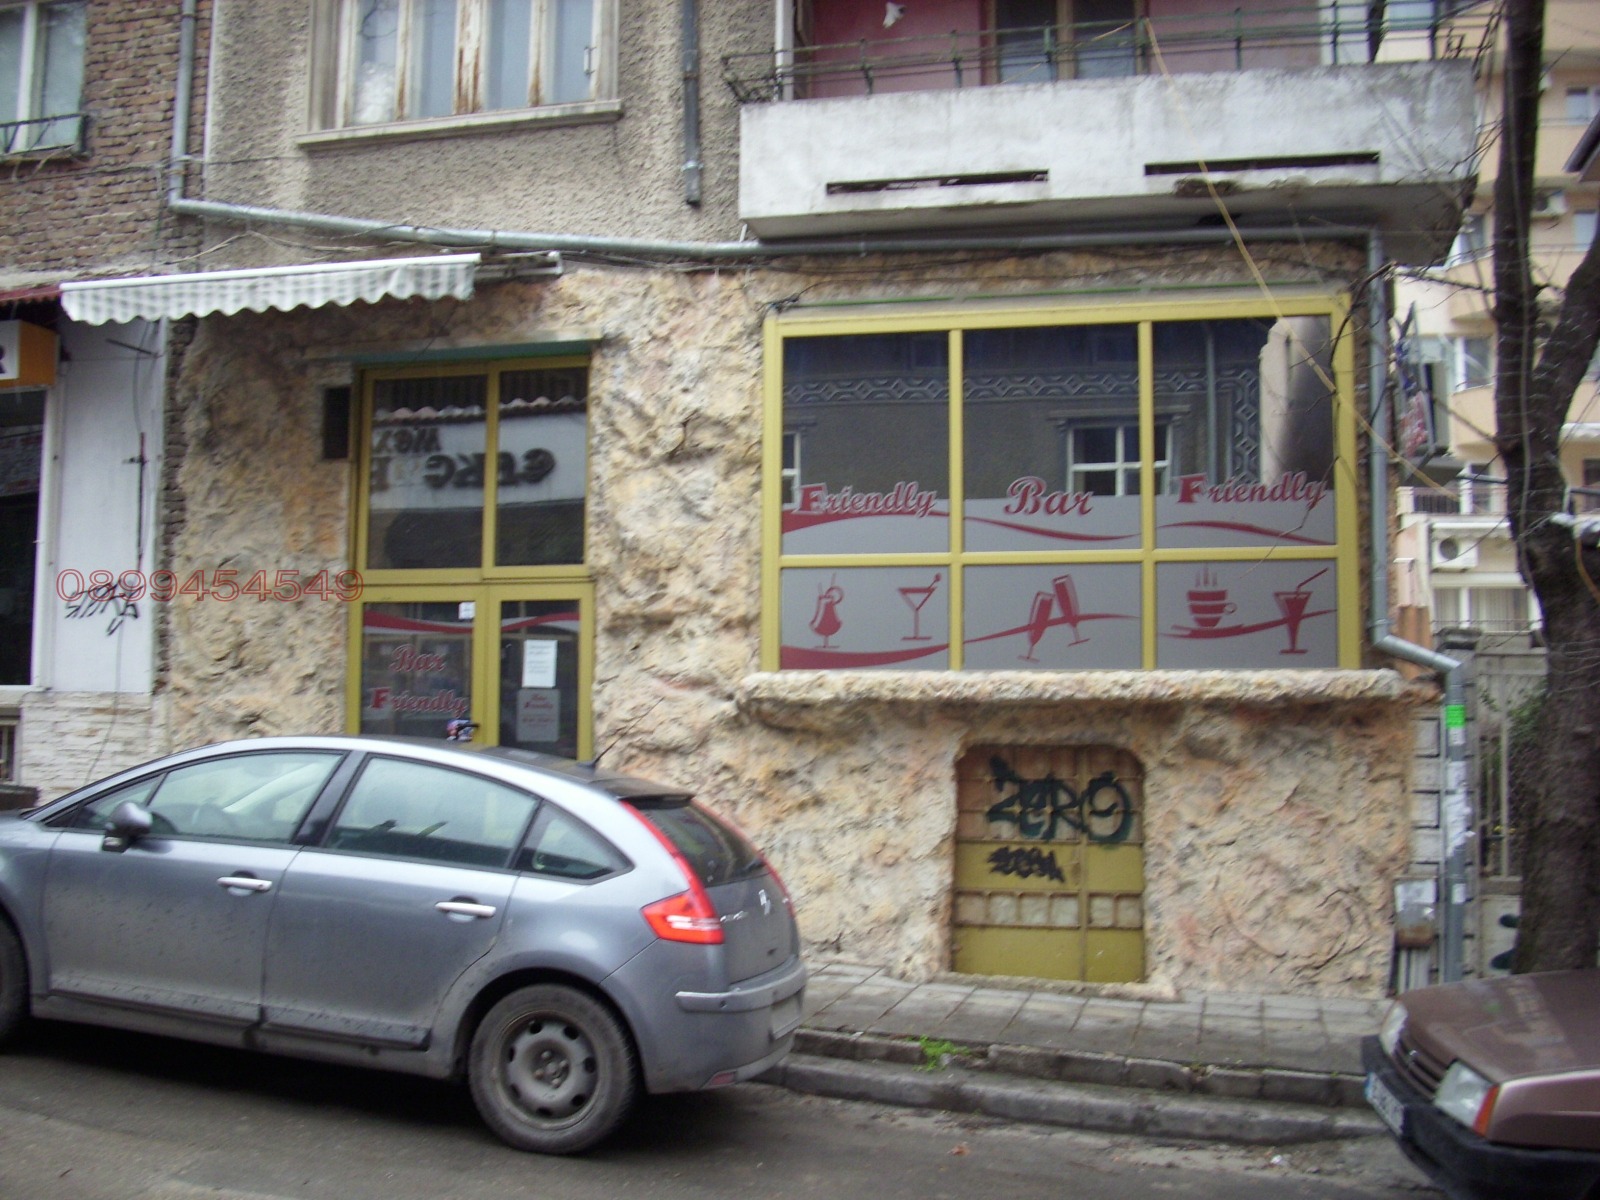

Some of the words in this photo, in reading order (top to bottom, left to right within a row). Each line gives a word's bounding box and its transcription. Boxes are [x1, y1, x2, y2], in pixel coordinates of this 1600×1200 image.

[792, 481, 937, 518] Friendly
[1004, 476, 1094, 515] Bar
[1176, 471, 1328, 511] Friendly
[389, 644, 447, 672] Bar
[368, 687, 469, 718] Friendly
